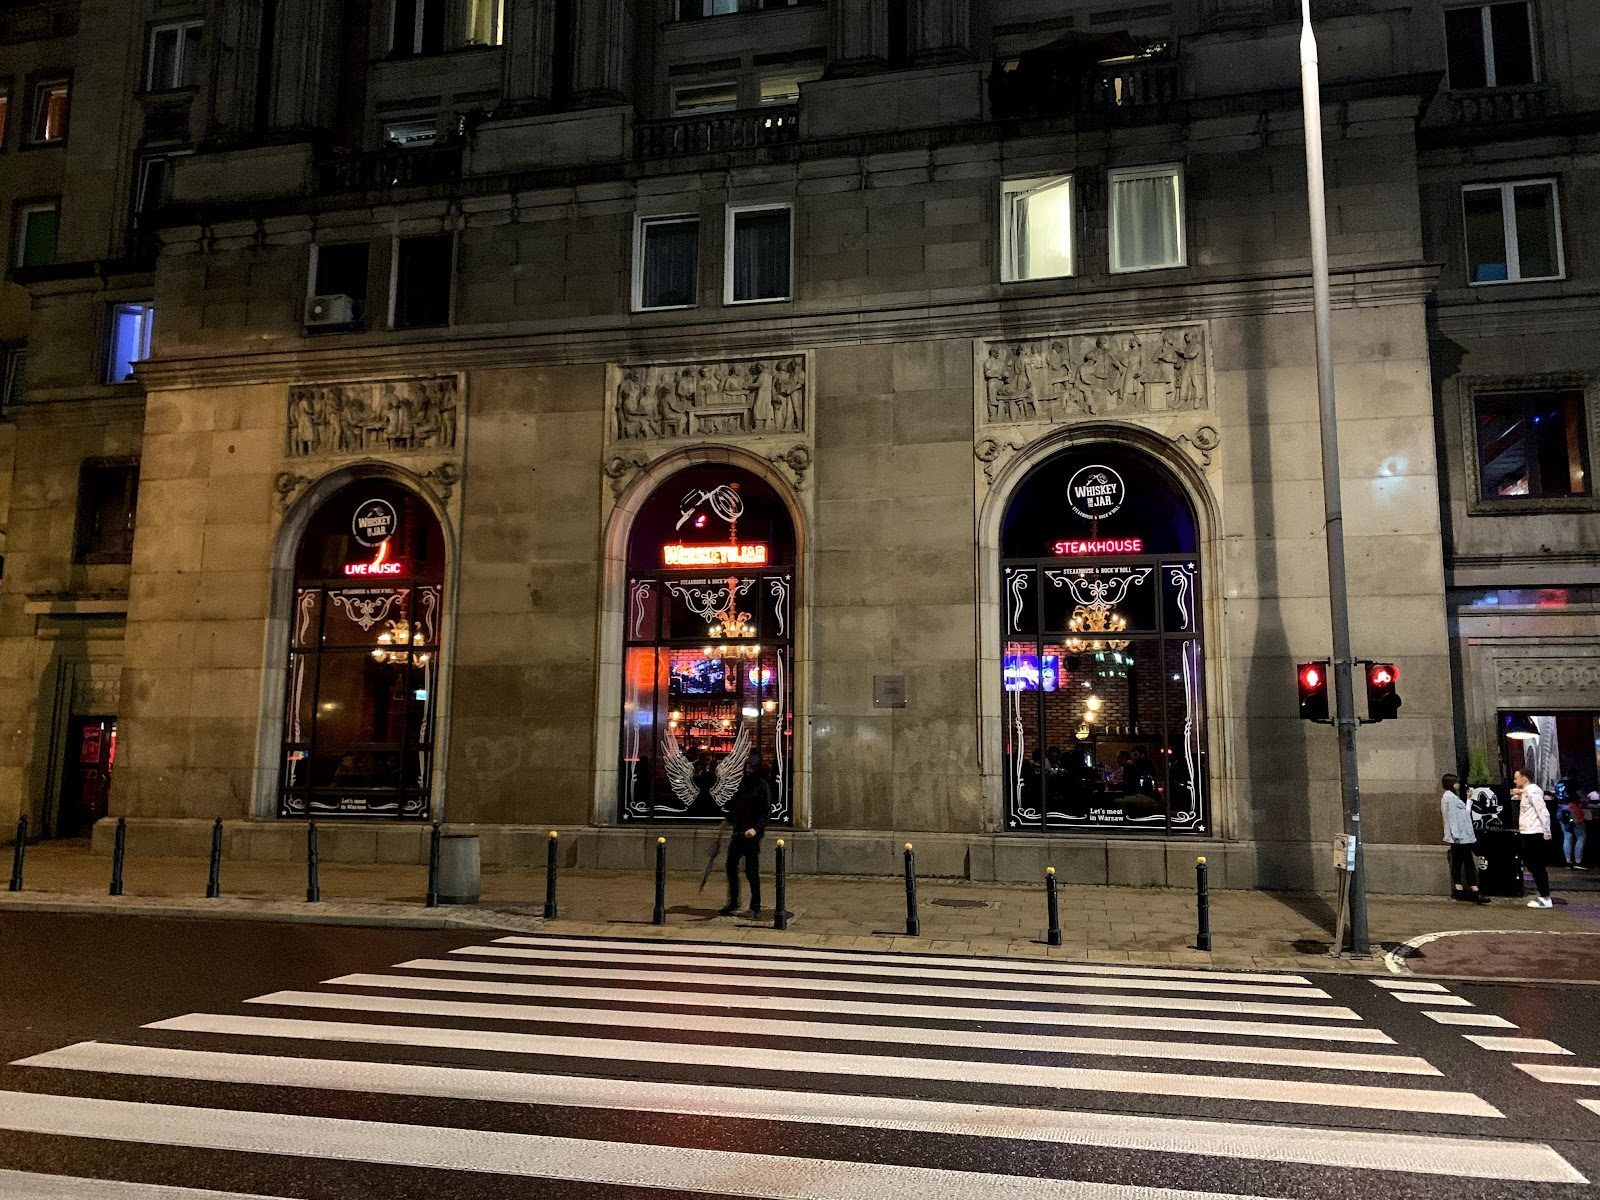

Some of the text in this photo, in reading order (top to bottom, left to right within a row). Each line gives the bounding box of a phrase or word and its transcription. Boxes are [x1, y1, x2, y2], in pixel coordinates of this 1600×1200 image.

[1074, 483, 1117, 498] WHISKEY
[358, 516, 390, 528] WHISKEY
[1054, 540, 1142, 554] STEAKHOUSE
[344, 562, 402, 574] LIVE MUSIC
